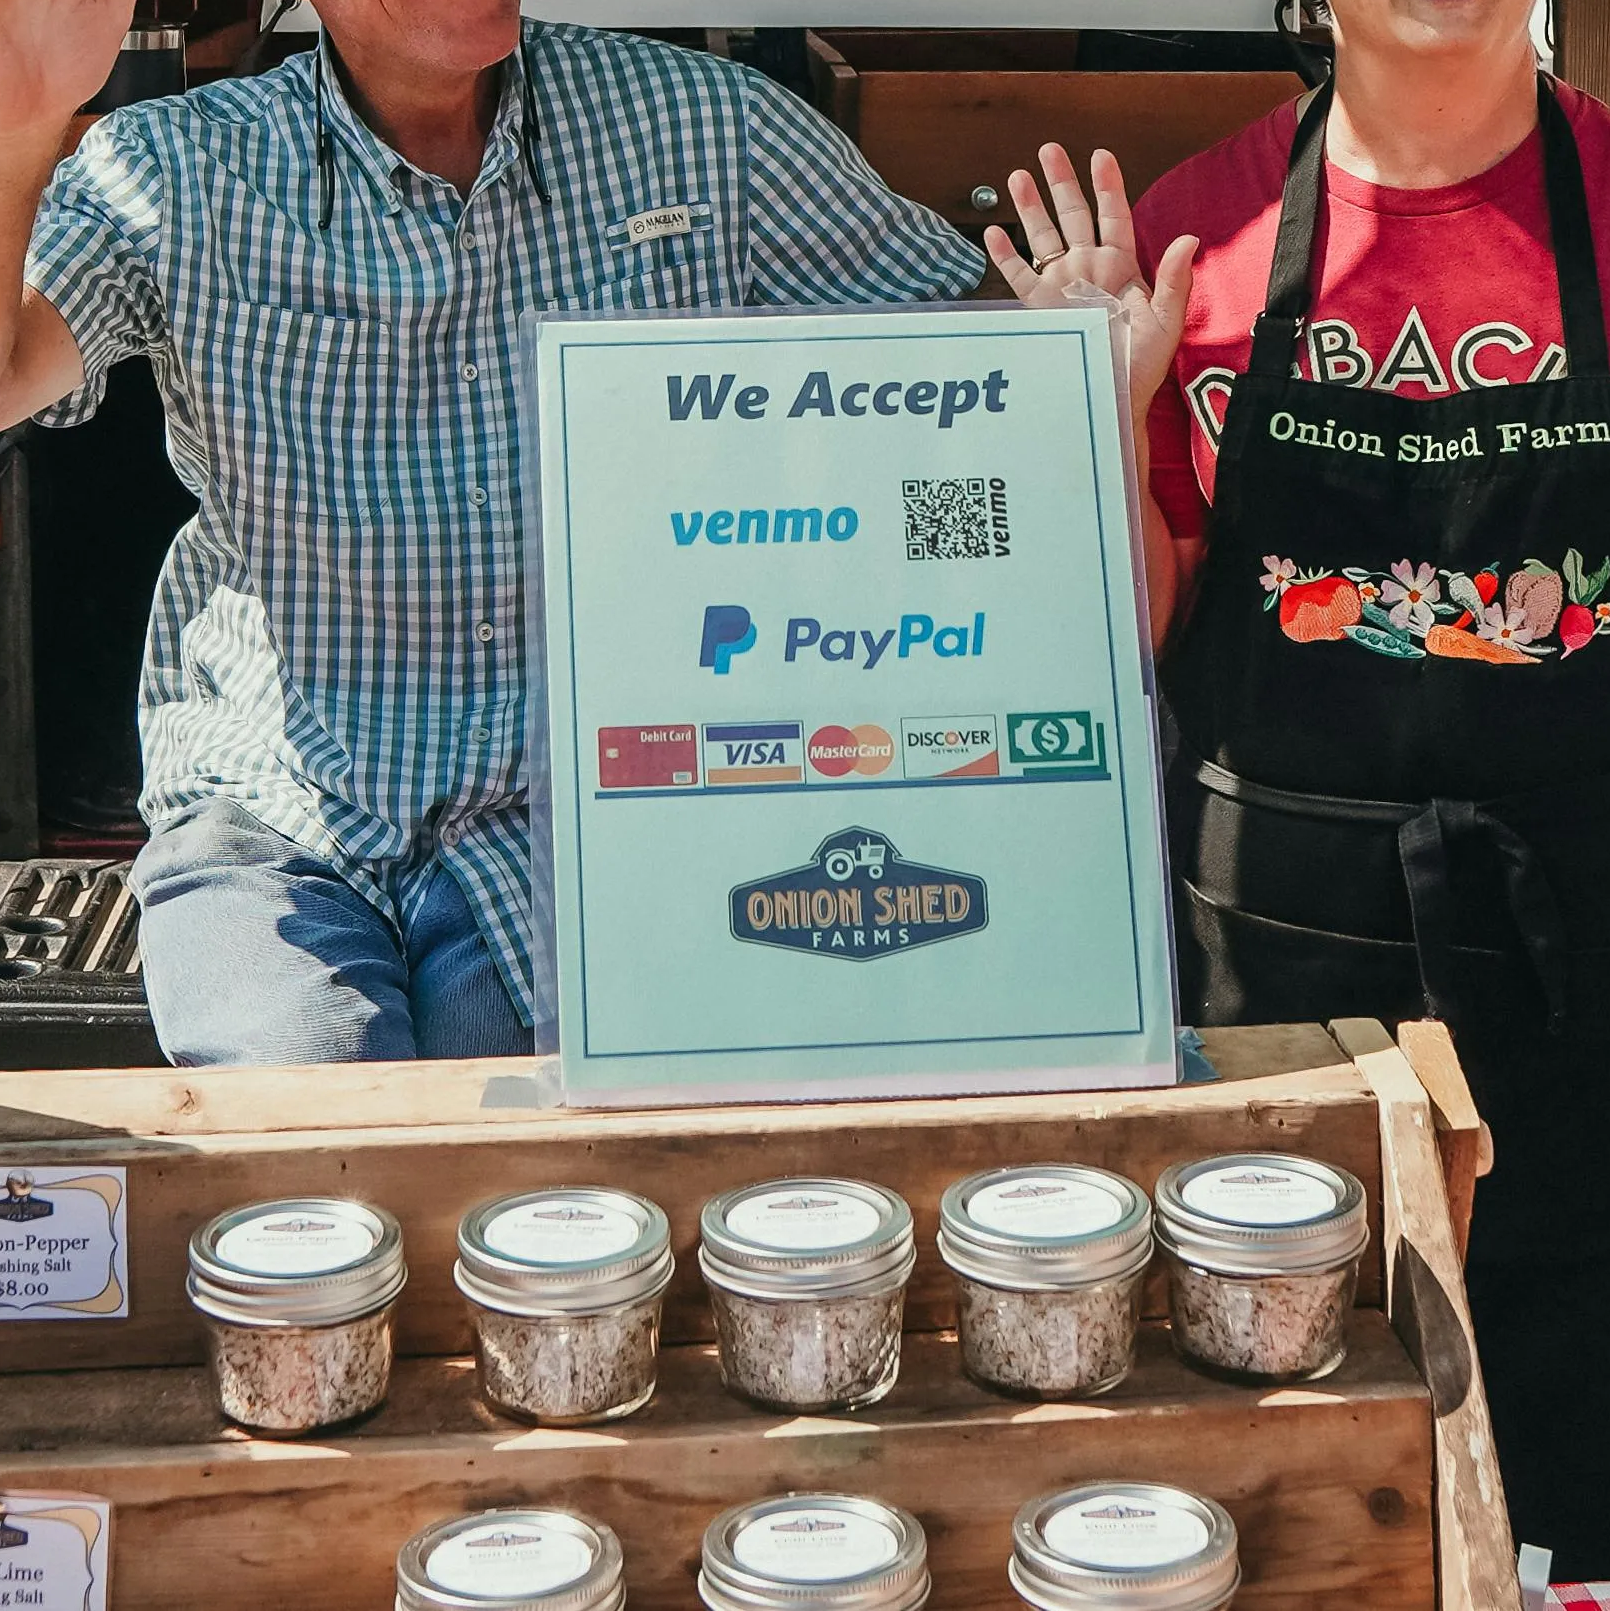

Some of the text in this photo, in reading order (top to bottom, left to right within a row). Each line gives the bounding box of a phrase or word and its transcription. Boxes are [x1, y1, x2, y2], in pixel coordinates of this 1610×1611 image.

[666, 368, 1011, 428] We Accept
[1269, 411, 1386, 459] Onion
[1396, 427, 1485, 464] Shed
[670, 505, 860, 547] venmo
[993, 476, 1011, 559] venmo
[784, 611, 987, 671] PayPal
[640, 729, 693, 743] Debit Card
[907, 729, 992, 748] DISCOVER
[723, 742, 787, 767] VISA
[809, 742, 892, 761] MasterCard
[746, 883, 971, 930] ONION SHED
[812, 928, 910, 948] FARMS
[43, 1257, 72, 1273] Salt
[14, 1588, 45, 1605] Salt
